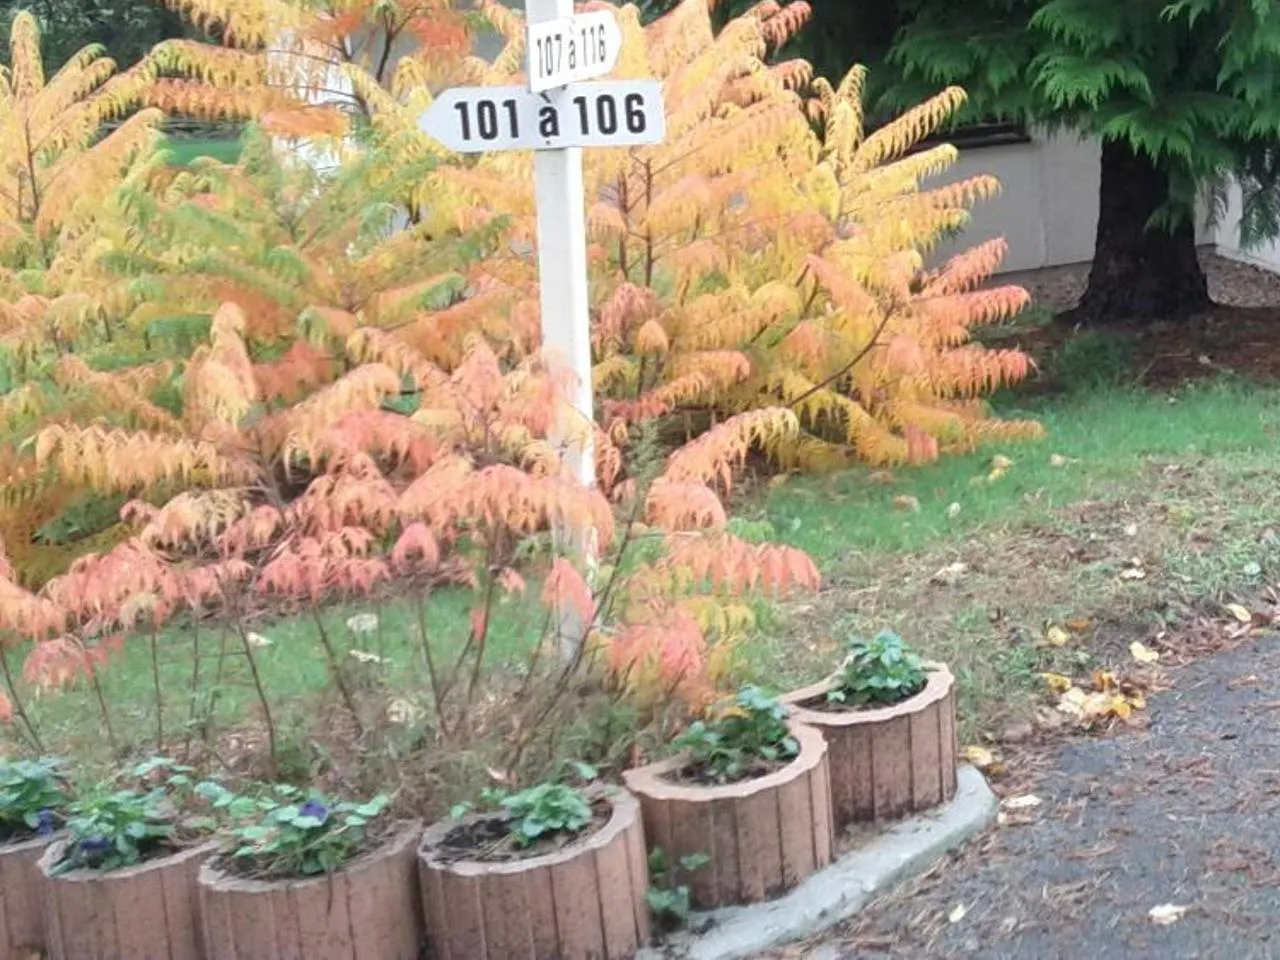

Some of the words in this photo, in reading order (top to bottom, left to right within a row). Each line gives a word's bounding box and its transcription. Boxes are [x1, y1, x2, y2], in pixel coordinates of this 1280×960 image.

[537, 33, 562, 78] 107
[568, 24, 576, 70] à
[581, 23, 606, 67] 116
[454, 98, 519, 141] 101
[539, 91, 560, 137] à
[573, 93, 647, 136] 106
